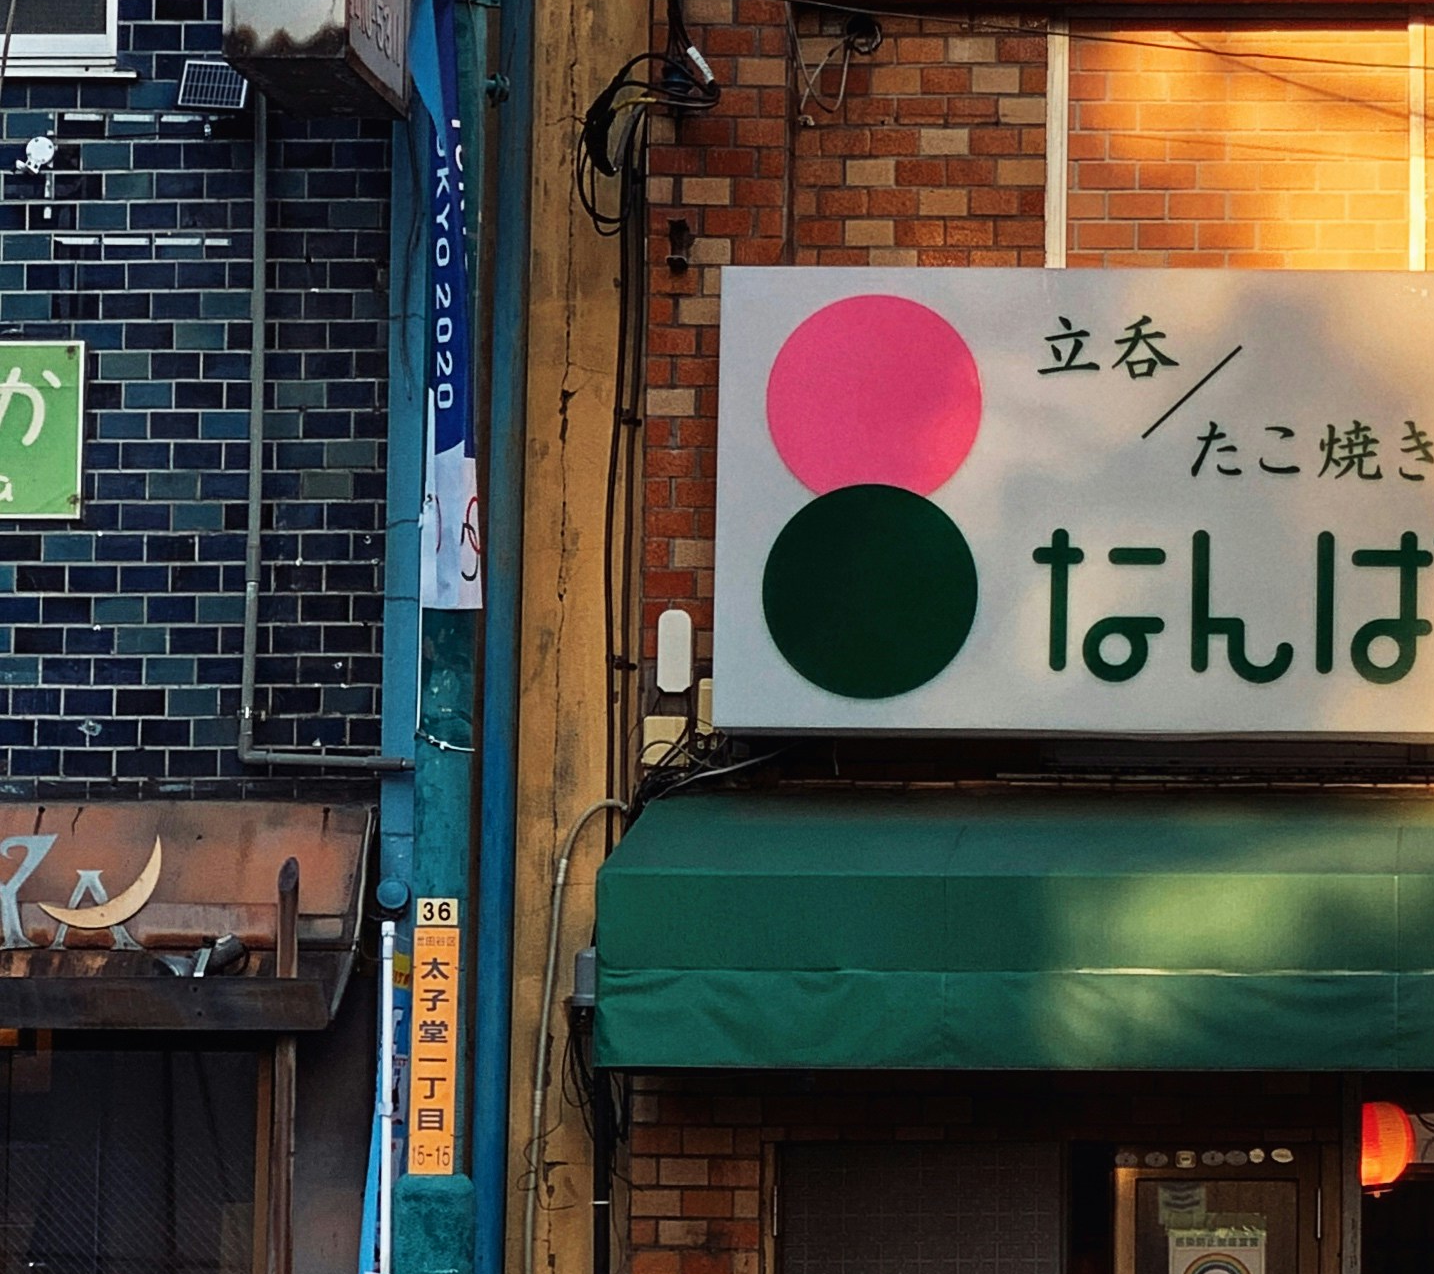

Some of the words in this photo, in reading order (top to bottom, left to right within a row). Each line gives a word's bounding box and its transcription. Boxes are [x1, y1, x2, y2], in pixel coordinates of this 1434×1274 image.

[435, 282, 453, 410] 2020
[1037, 314, 1180, 379] 立呑
[422, 901, 451, 922] 36
[418, 957, 450, 1132] 太子堂一丁目
[412, 1146, 450, 1166] 15-15
